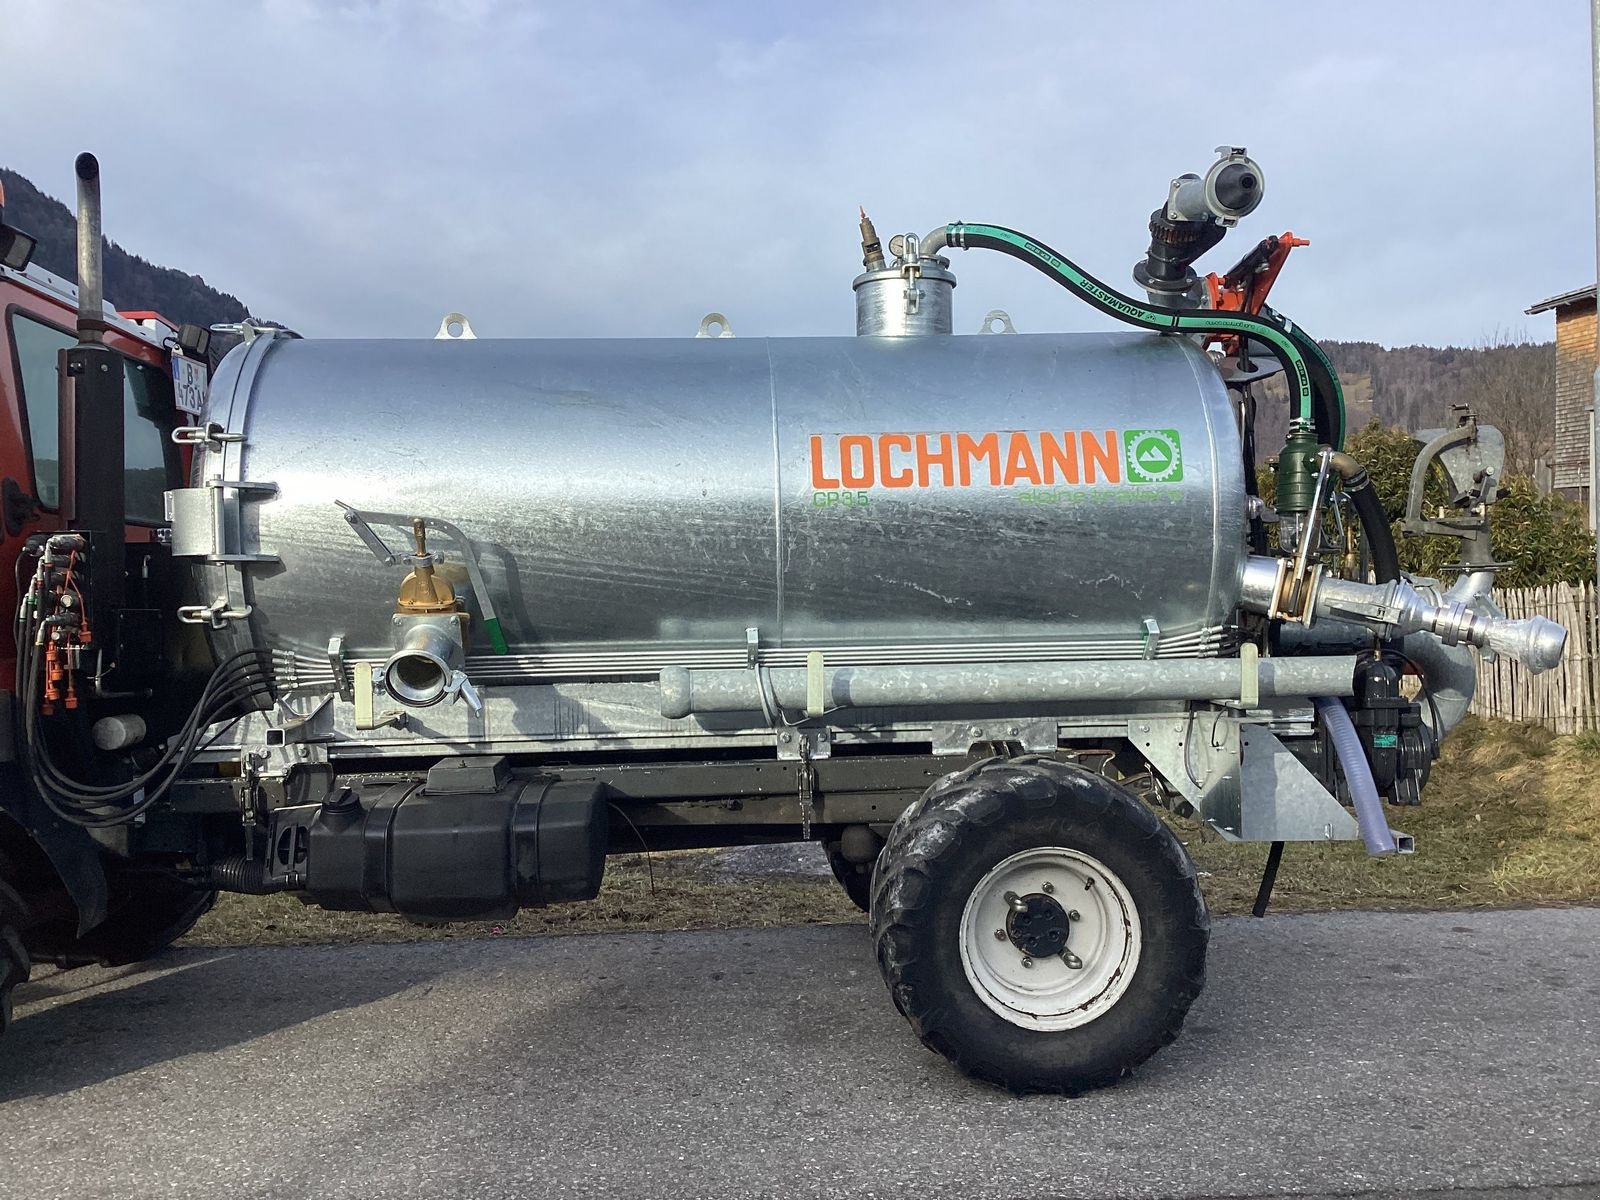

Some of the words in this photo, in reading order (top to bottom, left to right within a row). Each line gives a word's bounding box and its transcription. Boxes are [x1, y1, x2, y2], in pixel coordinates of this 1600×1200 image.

[1079, 279, 1146, 318] AQUAMASTER
[186, 363, 193, 385] B
[810, 430, 1121, 489] LOCHMANN
[1018, 489, 1087, 505] alpine
